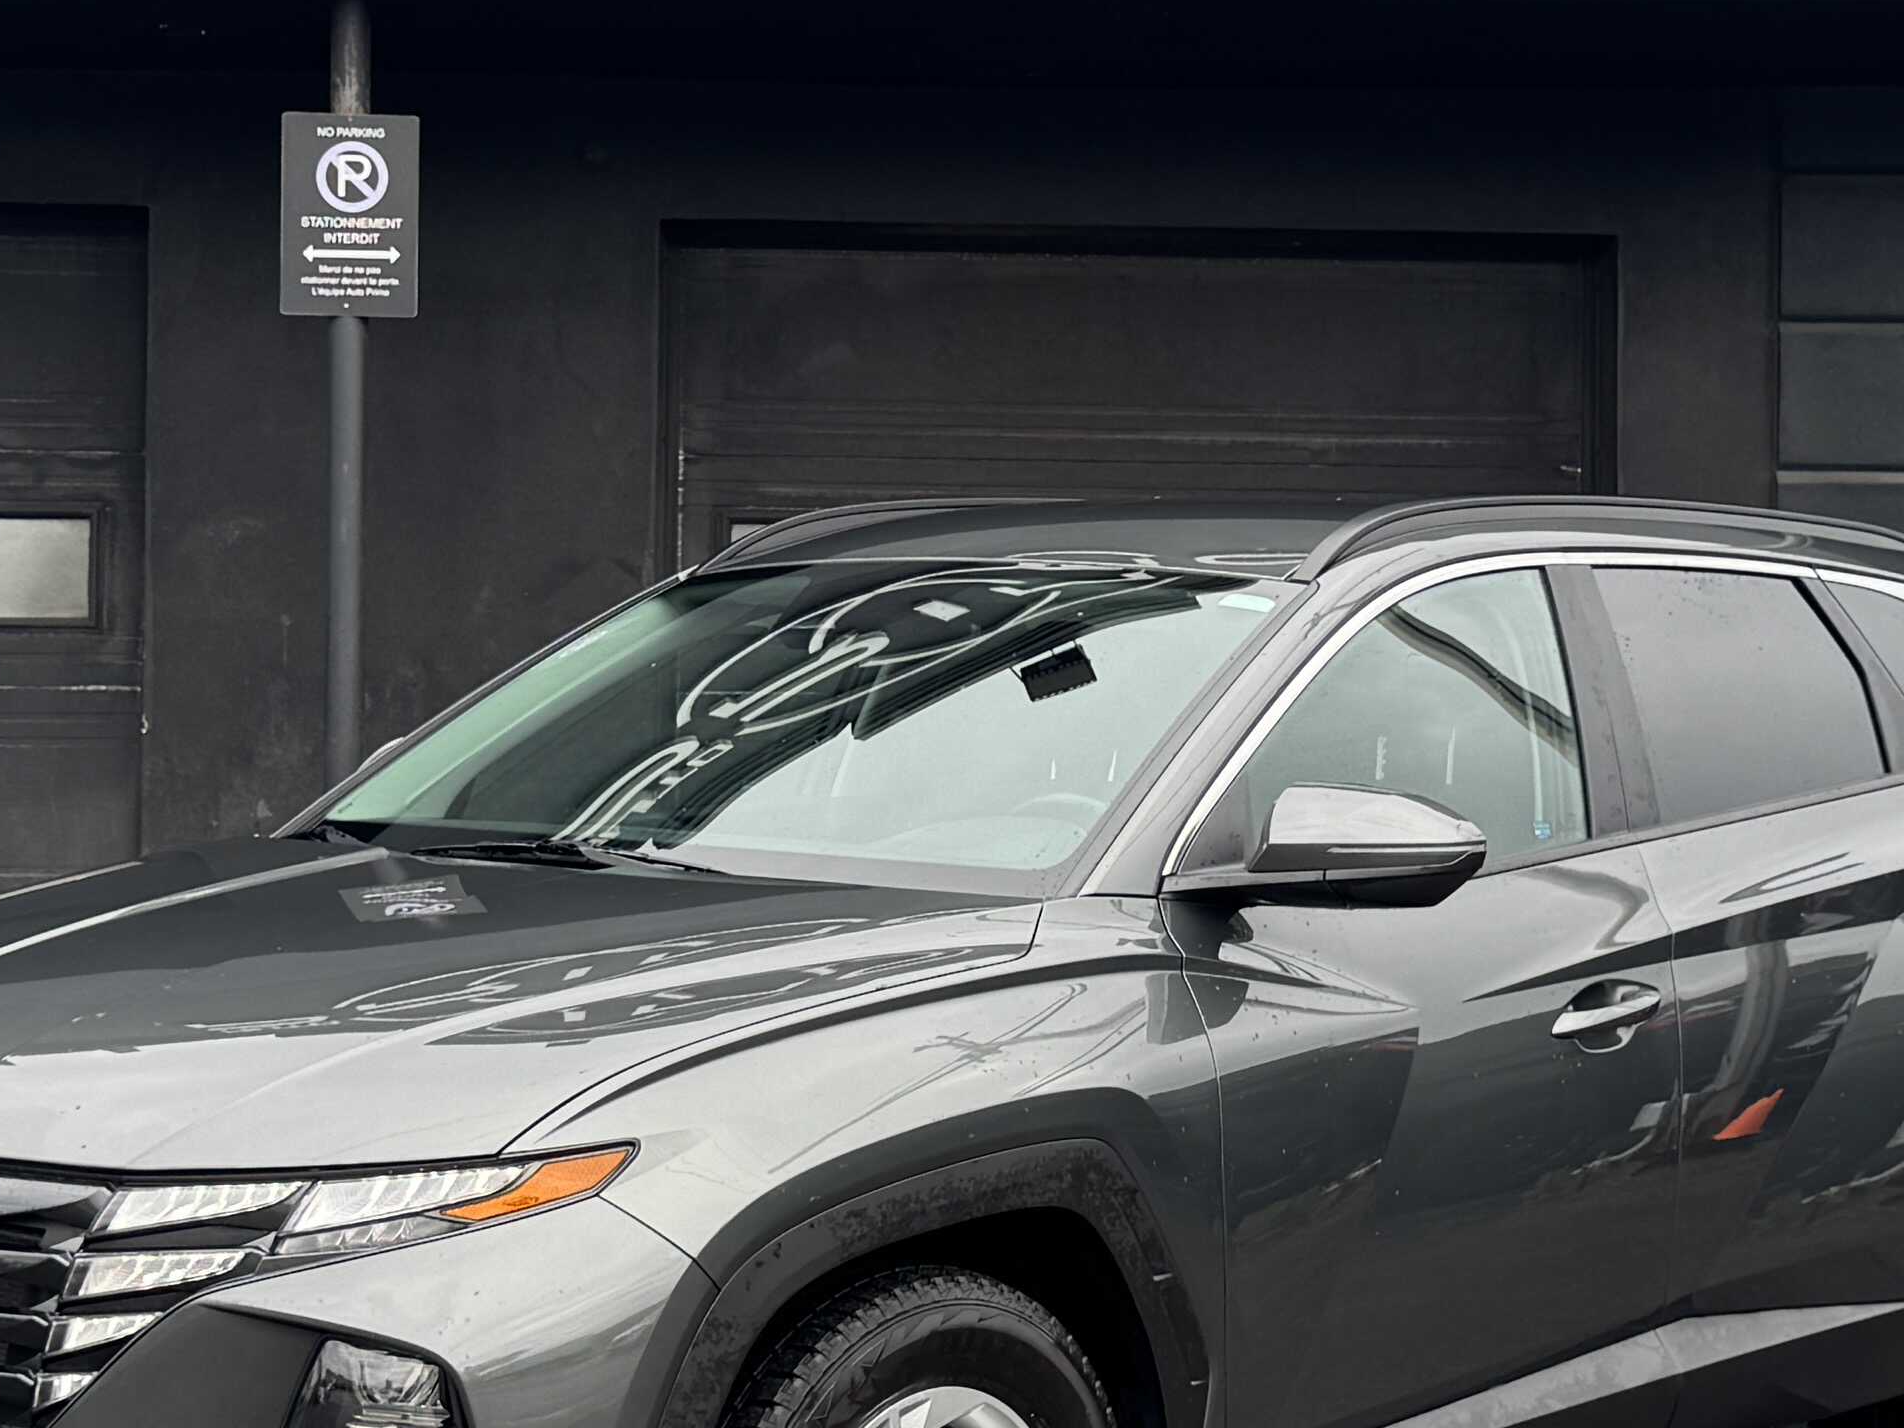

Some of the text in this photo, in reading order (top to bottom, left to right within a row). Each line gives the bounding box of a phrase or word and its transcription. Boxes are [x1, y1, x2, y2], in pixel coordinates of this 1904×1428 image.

[317, 126, 385, 139] NO PARKING
[301, 216, 403, 229] STATIONNEMENT
[323, 232, 380, 244] INTERDIT
